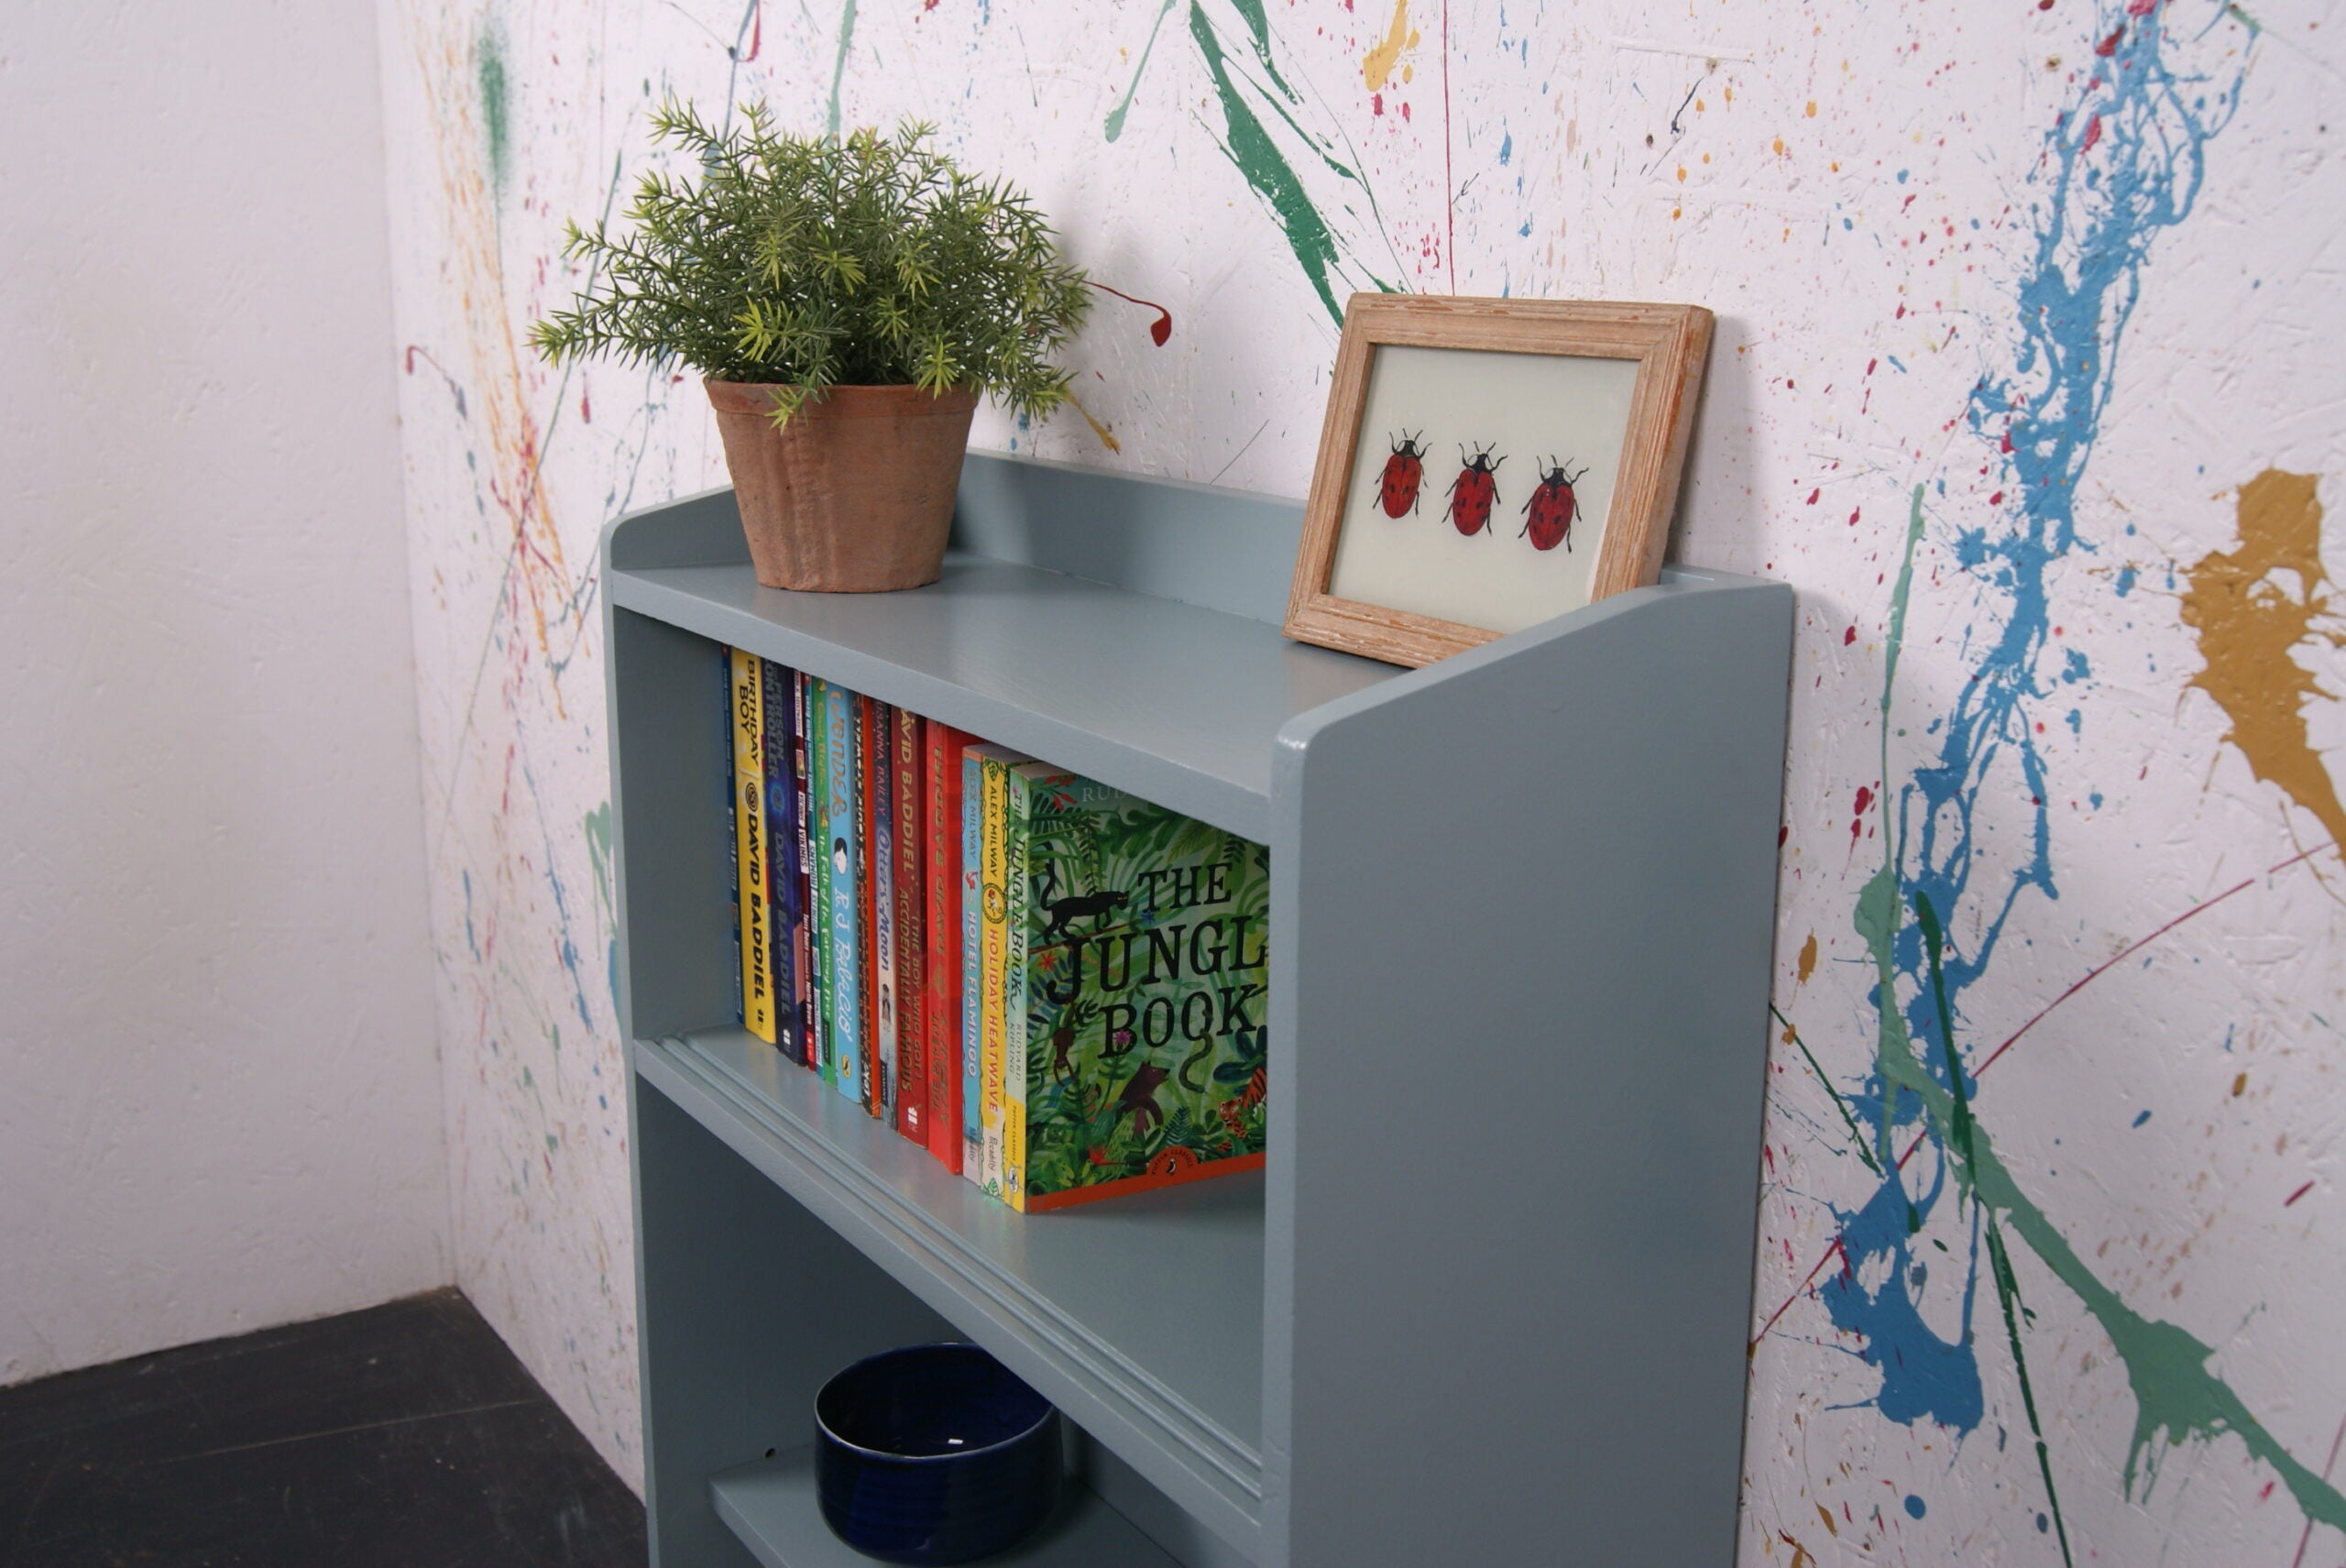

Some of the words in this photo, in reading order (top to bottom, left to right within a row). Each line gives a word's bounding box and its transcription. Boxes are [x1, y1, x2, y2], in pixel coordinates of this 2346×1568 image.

[739, 685, 751, 734] BOY
[747, 660, 760, 767] BIRTHDAY
[765, 660, 779, 778] ONTROLLER
[774, 681, 784, 760] PERSON
[901, 707, 912, 763] AVID
[855, 717, 863, 790] STOWELL
[902, 770, 915, 872] BADDIEL
[934, 746, 944, 867] BADDIEL
[969, 805, 977, 859] MILWAY
[990, 785, 998, 820] ALEX
[1013, 793, 1023, 825] THE
[748, 813, 760, 885] DAVID
[774, 831, 786, 903] DAVID
[799, 829, 807, 869] VIKINGS
[809, 844, 817, 886] ROMANS
[821, 855, 829, 885] Folk
[990, 823, 998, 877] MILWAY
[1011, 828, 1025, 928] JUNGLE
[821, 887, 829, 904] of
[936, 874, 946, 956] DAVID
[1137, 862, 1233, 914] THE
[751, 893, 765, 999] BADDIEL
[777, 907, 791, 1014] BADDIEL
[821, 927, 830, 984] Faraway
[879, 903, 890, 971] Moon
[899, 886, 911, 1008] ACCIDENTALLY
[967, 911, 976, 970] HOTEL
[989, 928, 999, 1010] HOLIDAY
[1010, 931, 1025, 1011] BOOK
[901, 1011, 913, 1092] FAMOUS
[968, 976, 977, 1078] FLAMINGO
[1014, 1023, 1022, 1081] RUDYARD
[1098, 982, 1259, 1058] BOOK
[989, 1014, 999, 1113] HEATWAVE
